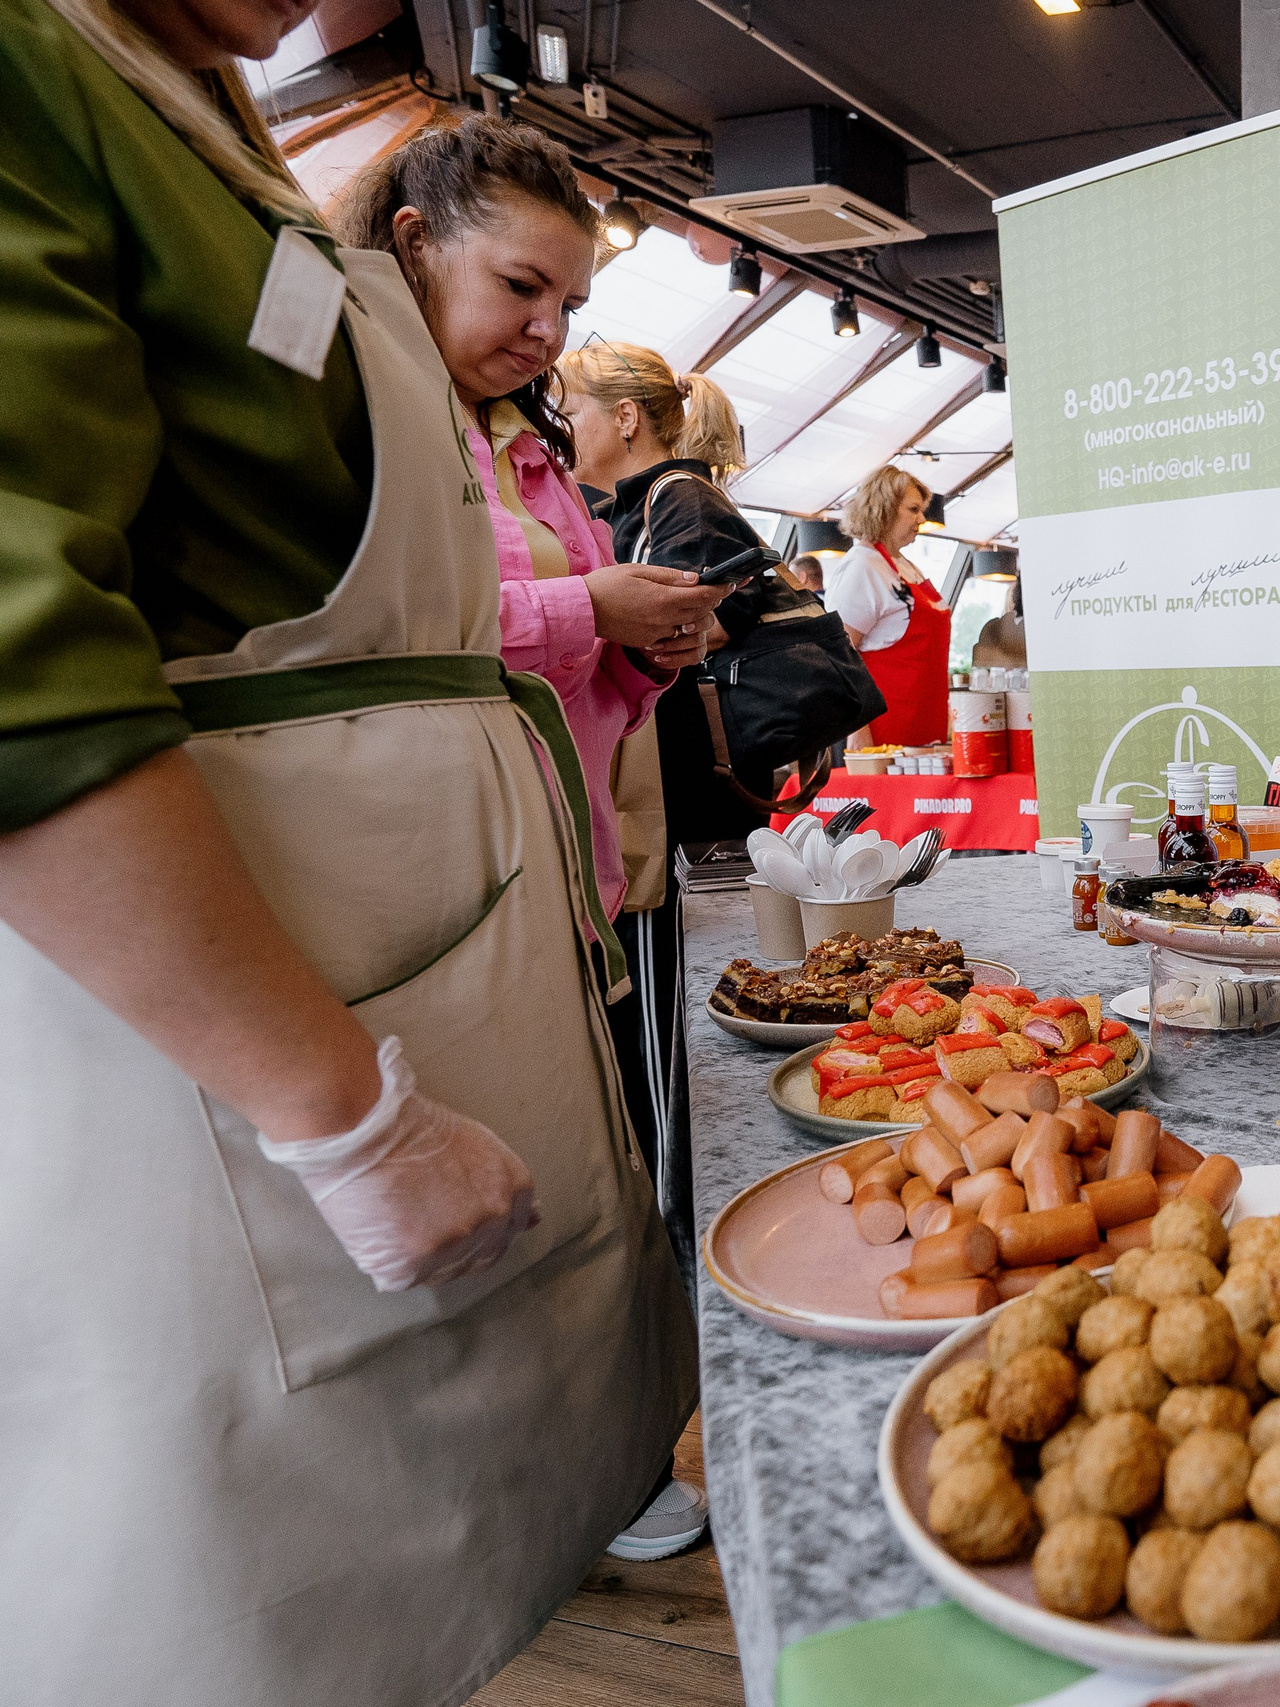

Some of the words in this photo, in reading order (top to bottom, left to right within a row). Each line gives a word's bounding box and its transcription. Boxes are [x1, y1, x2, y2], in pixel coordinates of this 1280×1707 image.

[1084, 400, 1265, 451] (многоканальный)
[1098, 450, 1250, 490] HQ-info@ak-e.ru
[1070, 594, 1157, 616] ПРОДУКТЫ
[1165, 597, 1194, 613] для
[1019, 799, 1039, 815] PIKA
